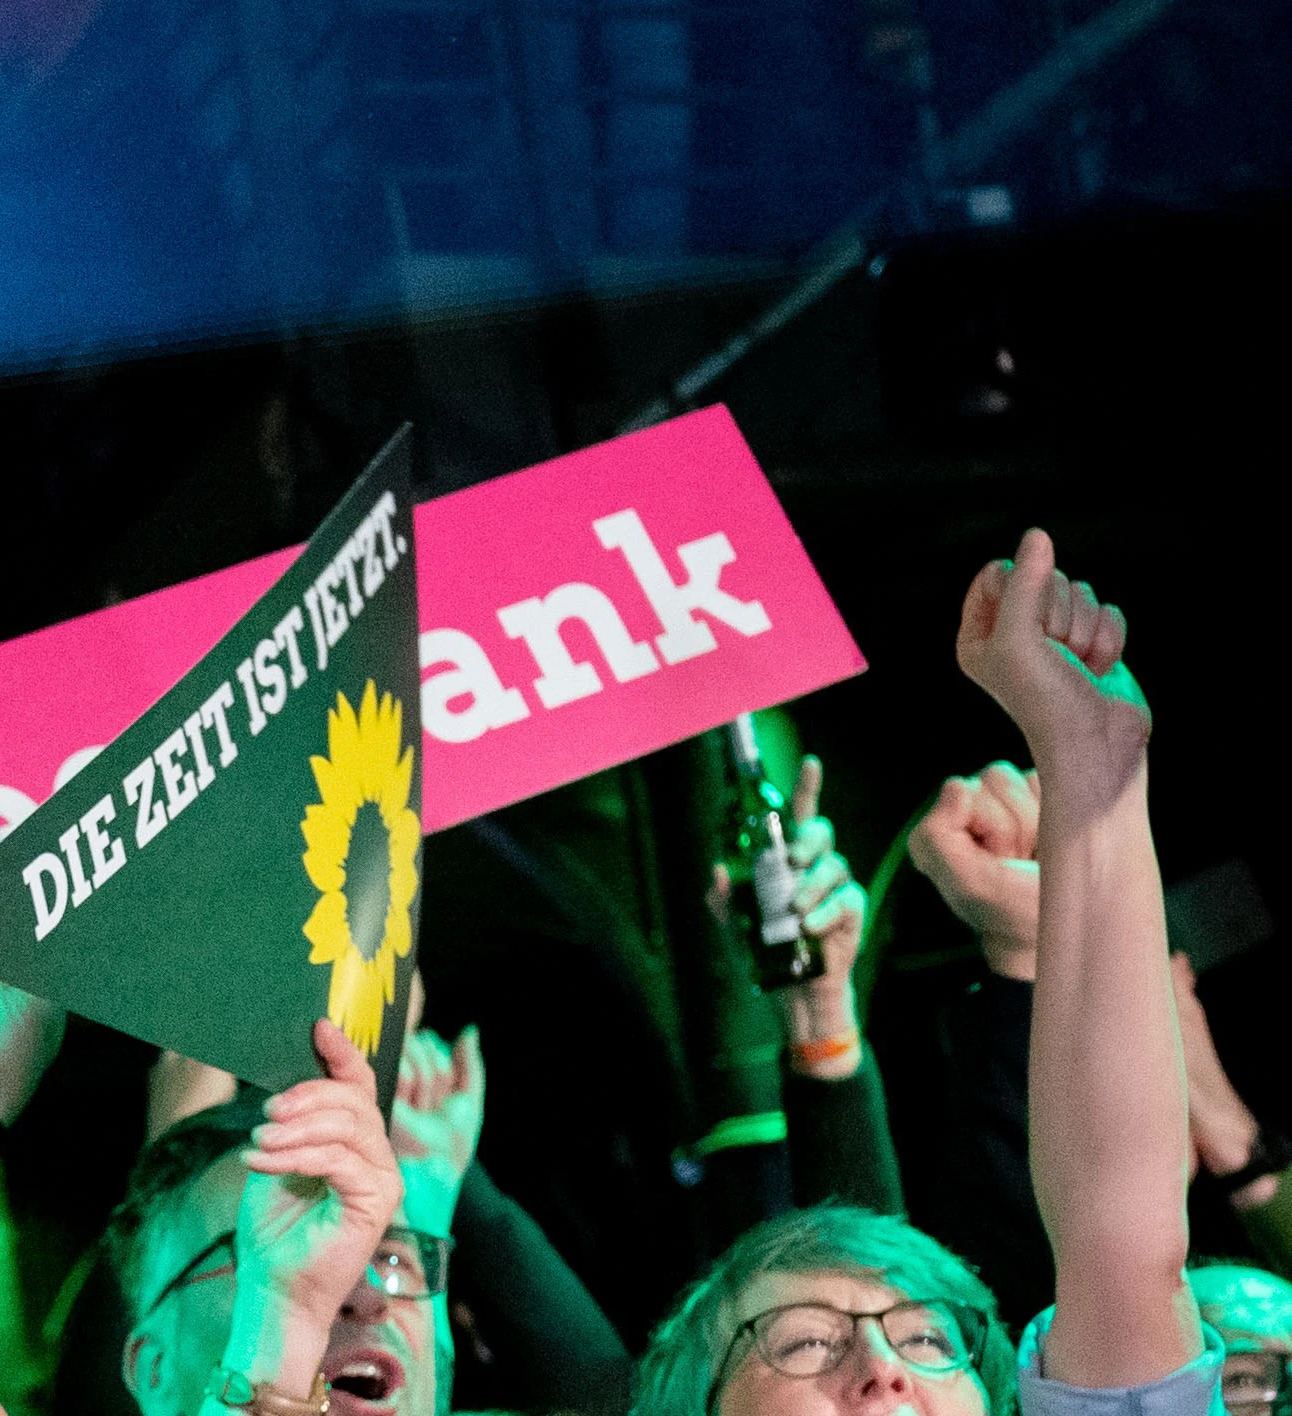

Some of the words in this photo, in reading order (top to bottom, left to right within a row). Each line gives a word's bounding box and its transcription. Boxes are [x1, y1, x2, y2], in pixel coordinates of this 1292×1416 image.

[21, 793, 127, 942] DIE
[121, 680, 239, 850] ZEIT
[235, 604, 308, 736] IST
[303, 490, 407, 671] JETZT.
